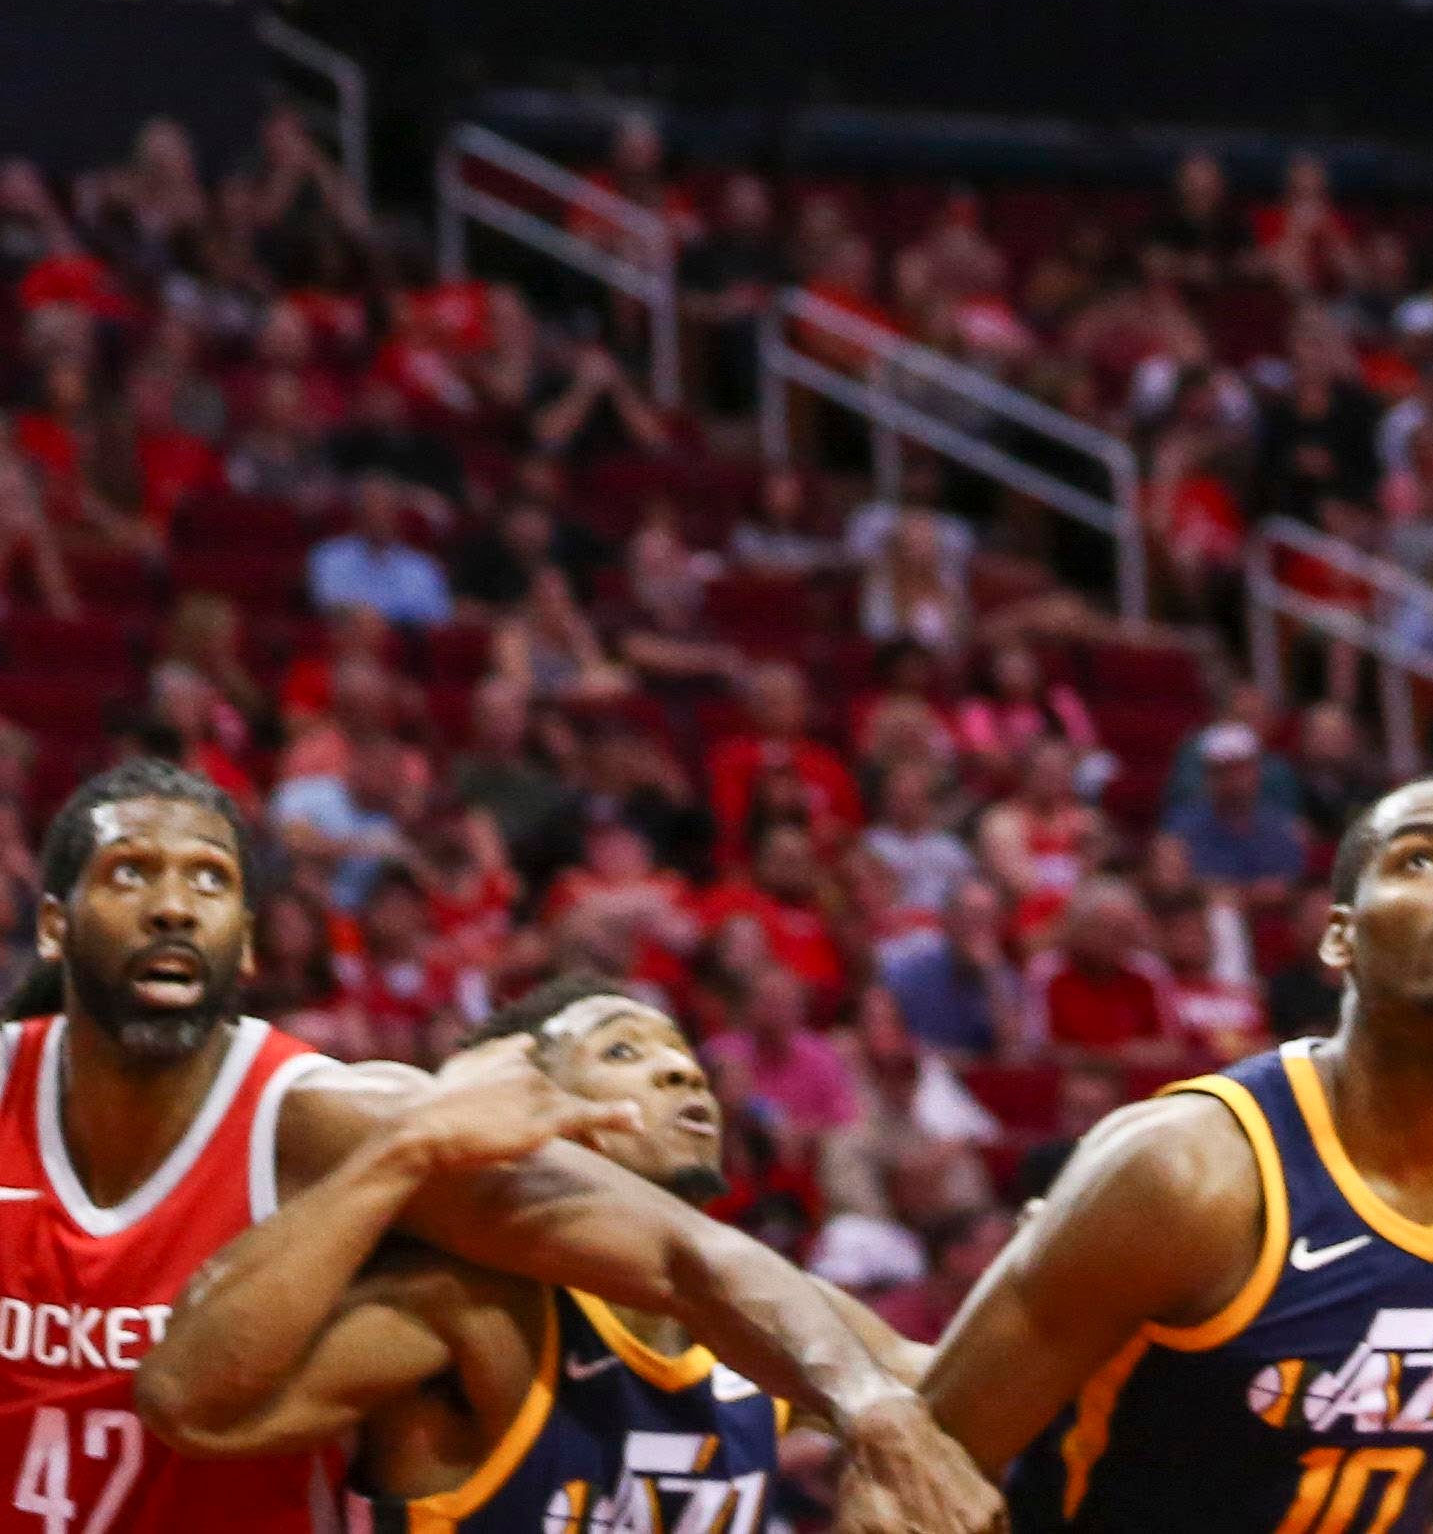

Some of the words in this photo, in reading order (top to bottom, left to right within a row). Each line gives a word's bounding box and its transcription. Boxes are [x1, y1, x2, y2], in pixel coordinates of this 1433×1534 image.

[0, 1296, 173, 1370] OCKET
[13, 1405, 144, 1534] 42
[1273, 1446, 1427, 1534] 10
